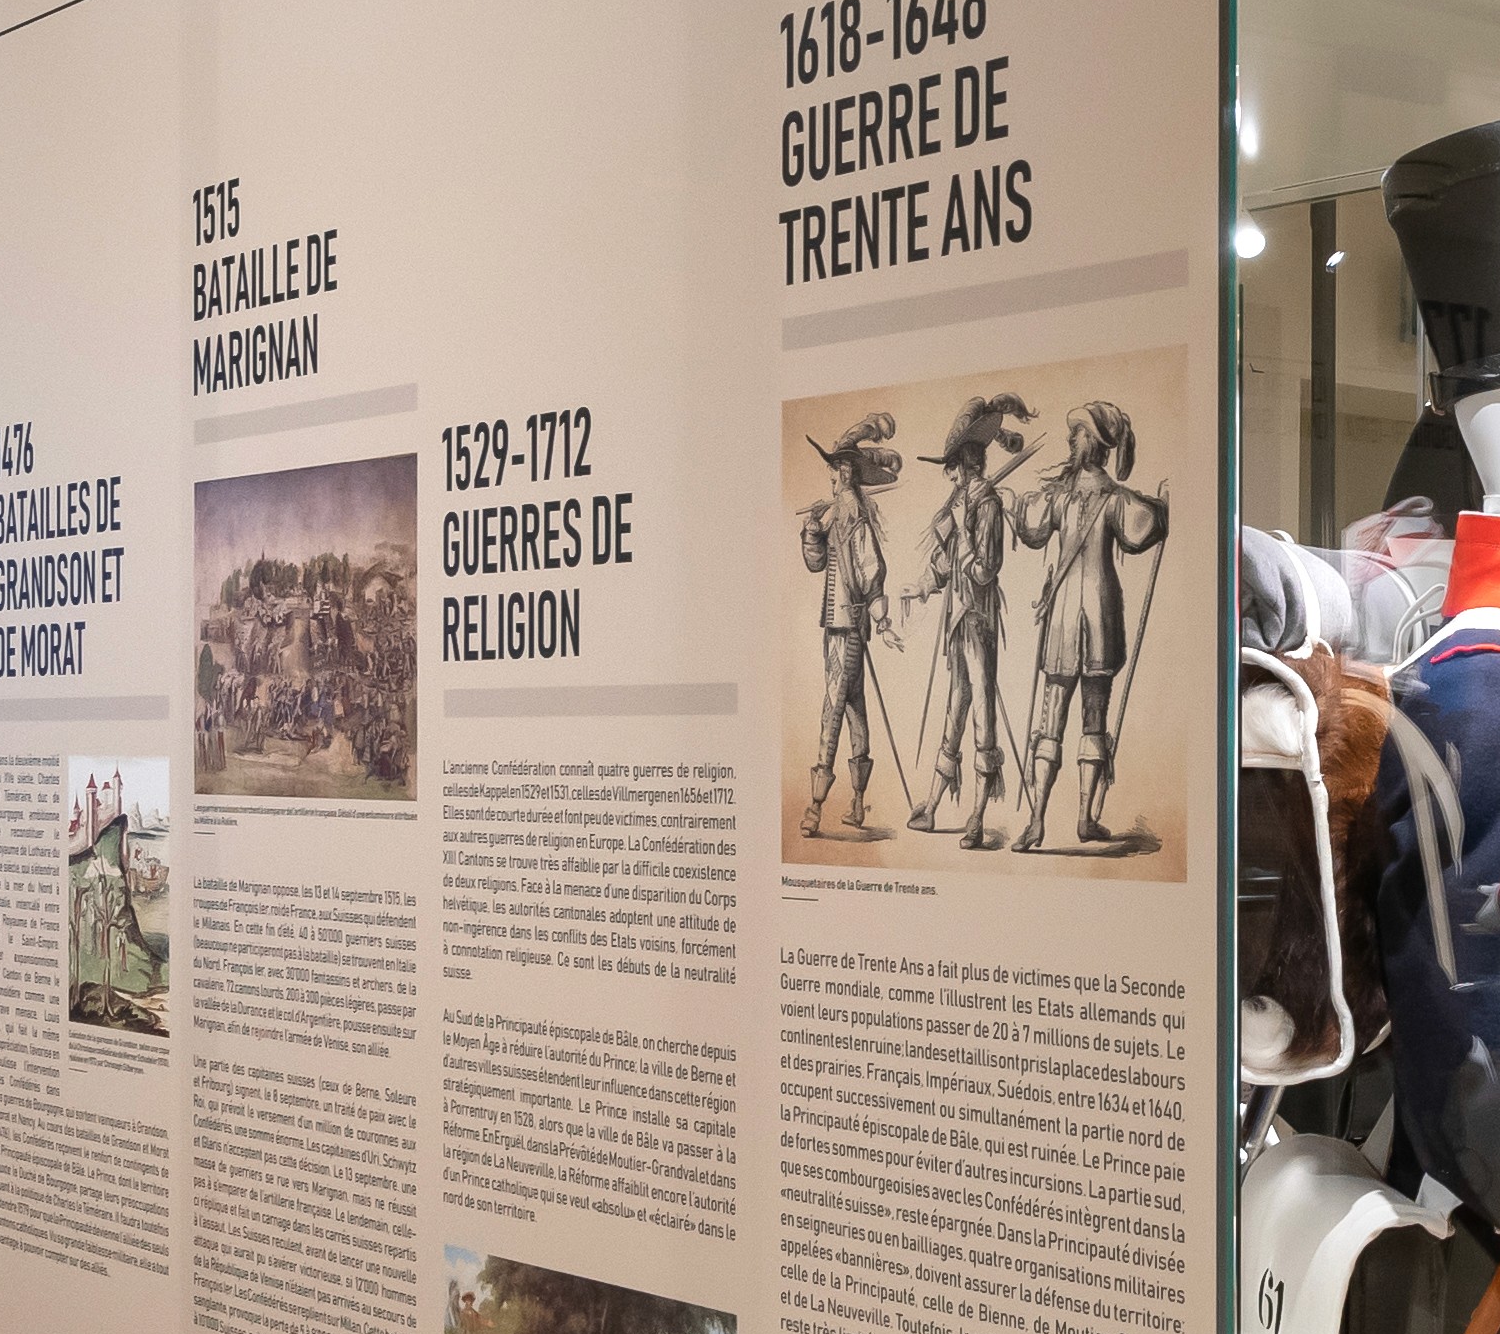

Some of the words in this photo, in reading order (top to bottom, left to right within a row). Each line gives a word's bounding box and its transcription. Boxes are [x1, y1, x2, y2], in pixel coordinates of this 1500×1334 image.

[781, 73, 942, 188] GUERRE
[954, 55, 1010, 149] DE
[192, 177, 240, 247] 1515
[778, 180, 930, 286] TRENTE
[940, 159, 1032, 257] ANS
[193, 238, 300, 322] BATAILLE
[306, 229, 338, 296] DE
[193, 314, 318, 397] MARIGNAN
[441, 406, 592, 492] 1529-1712
[96, 475, 121, 533] DE
[443, 498, 582, 578] GUERRES
[592, 492, 633, 566] DE
[101, 546, 125, 604] ET
[21, 621, 86, 678] MORAT
[442, 588, 580, 662] RELIGION
[442, 760, 489, 776] L'ancienne
[491, 759, 556, 777] Confédération
[559, 759, 595, 777] connaît
[597, 763, 630, 781] quatre
[632, 765, 674, 782] guerres
[676, 762, 690, 779] de
[780, 947, 795, 965] La
[797, 947, 838, 968] Guerre
[840, 952, 856, 970] de
[857, 952, 897, 974] Trente
[899, 956, 924, 976] Ans
[926, 963, 935, 977] a
[937, 959, 959, 979] fait
[961, 962, 990, 984] plus
[992, 964, 1009, 984] de
[1012, 966, 1071, 989] victimes
[1073, 976, 1101, 996] que
[1103, 973, 1117, 994] la
[1120, 975, 1186, 1000] Seconde
[780, 973, 821, 993] Guerre
[825, 980, 884, 1001] mondiale,
[888, 987, 935, 1005] comme
[939, 987, 1007, 1012] l'illustrent
[1012, 994, 1033, 1015] les
[1038, 997, 1074, 1019] Etats
[1079, 1001, 1157, 1028] allemands
[1162, 1010, 1186, 1033] qui
[780, 1081, 833, 1103] occupent
[835, 1089, 936, 1116] successivement
[939, 1104, 956, 1119] ou
[958, 1103, 1061, 1135] simultanément
[1065, 1116, 1078, 1137] la
[1081, 1123, 1125, 1143] partie
[1128, 1129, 1163, 1149] nord
[1167, 1131, 1186, 1152] de
